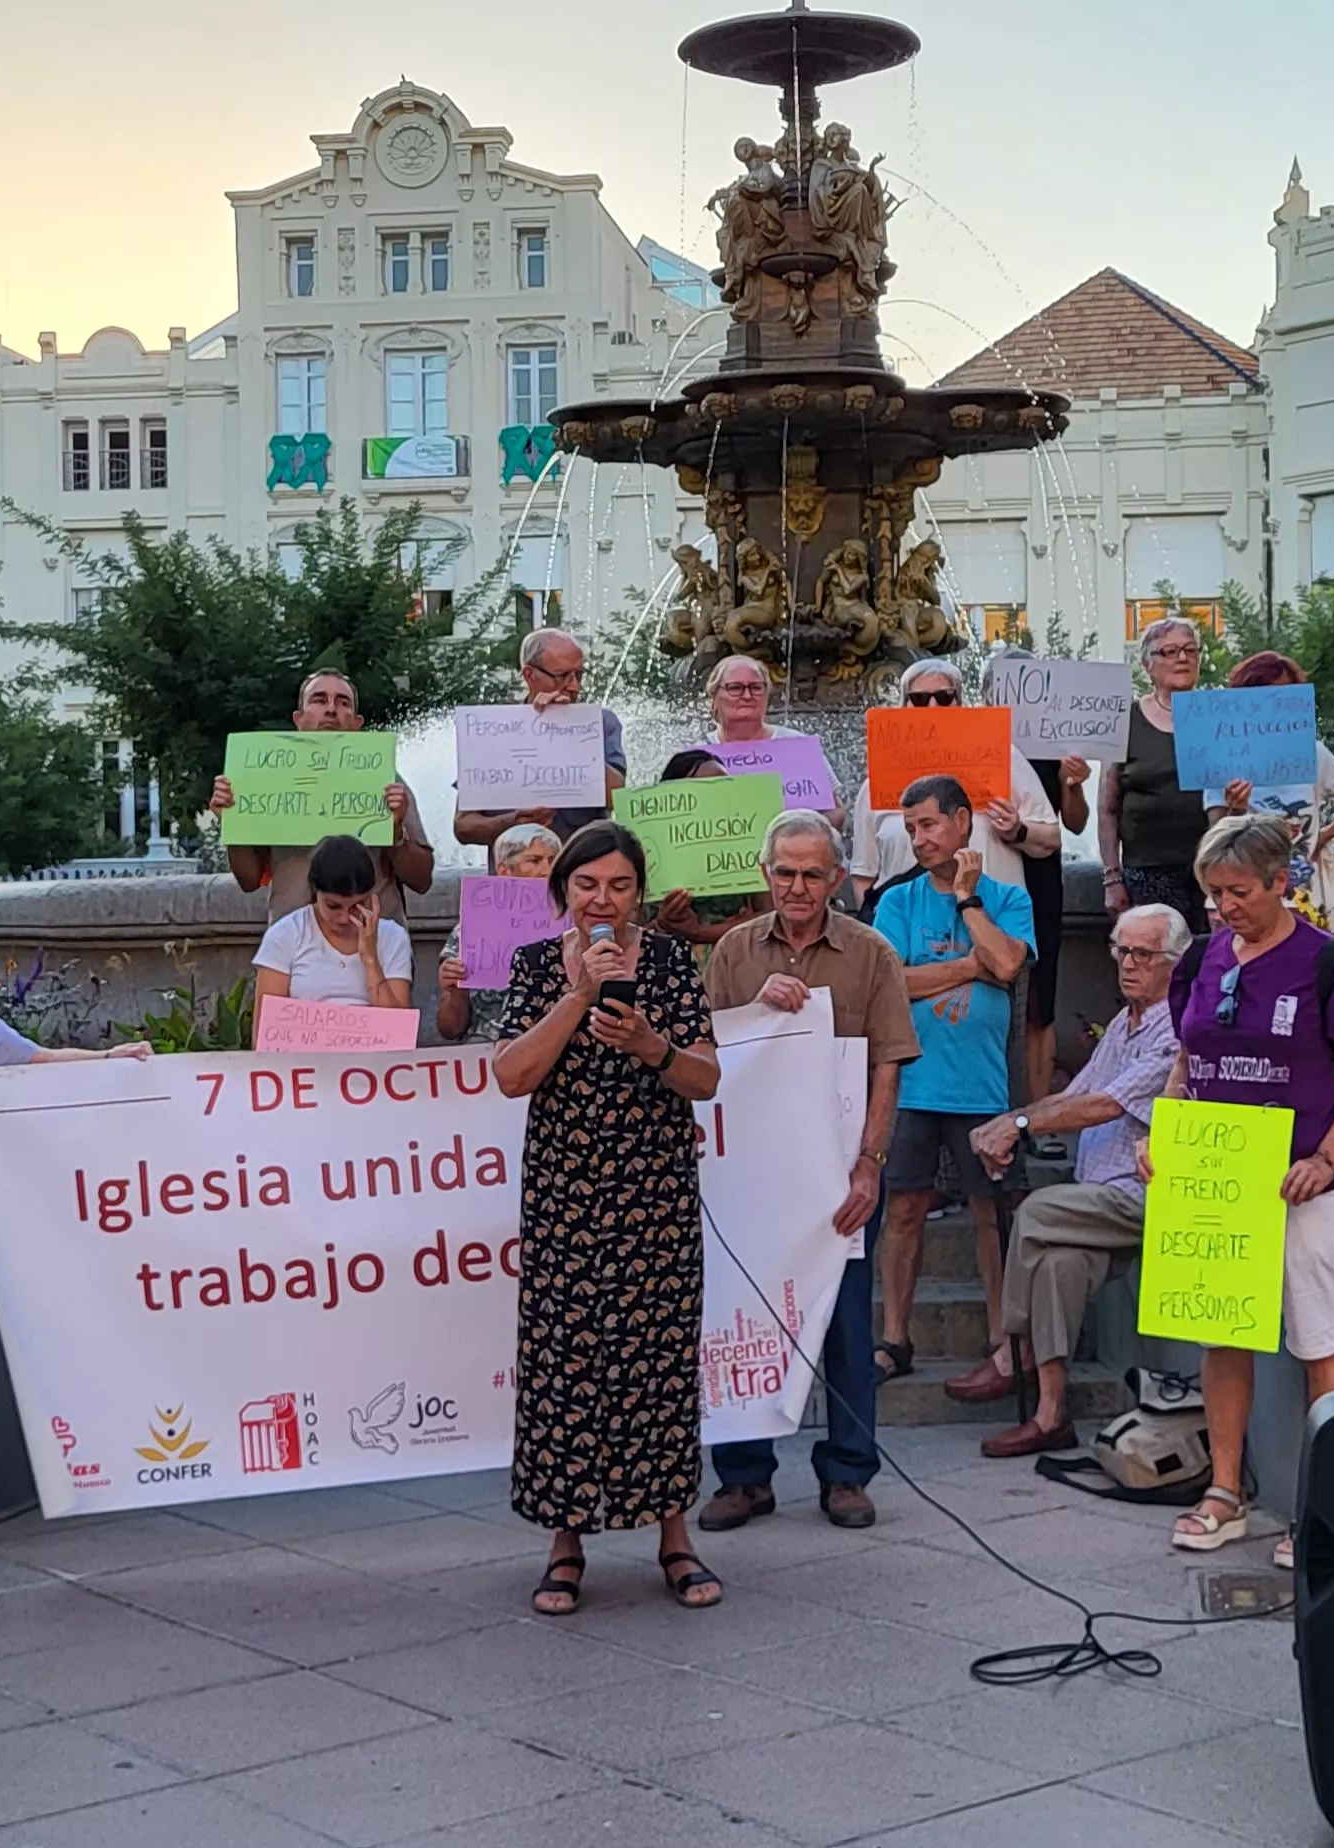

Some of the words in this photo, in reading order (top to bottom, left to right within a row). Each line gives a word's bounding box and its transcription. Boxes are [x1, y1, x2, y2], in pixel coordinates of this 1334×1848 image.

[1069, 694, 1127, 712] DESCARTE
[464, 712, 527, 738] PERSONAS
[244, 748, 297, 769] LUCRO
[522, 764, 590, 787] DECENTE
[238, 792, 312, 816] DESCARTE
[669, 812, 757, 844] INCLUSIÓN
[300, 1031, 319, 1045] NO
[195, 1072, 225, 1116] 7
[249, 1067, 319, 1114] DE
[339, 1057, 488, 1106] OCTU
[1173, 1119, 1247, 1152] LUCRO
[1197, 1156, 1223, 1169] SIN
[74, 1153, 292, 1233] Iglesia
[320, 1133, 509, 1202] unida
[1169, 1175, 1242, 1203] FRENO
[1160, 1230, 1252, 1261] DESCARTE
[136, 1242, 386, 1312] trabajo
[1159, 1291, 1258, 1336] PERSONAS
[699, 1337, 778, 1366] decente
[408, 1393, 460, 1429] joc
[137, 1462, 213, 1485] CONFER
